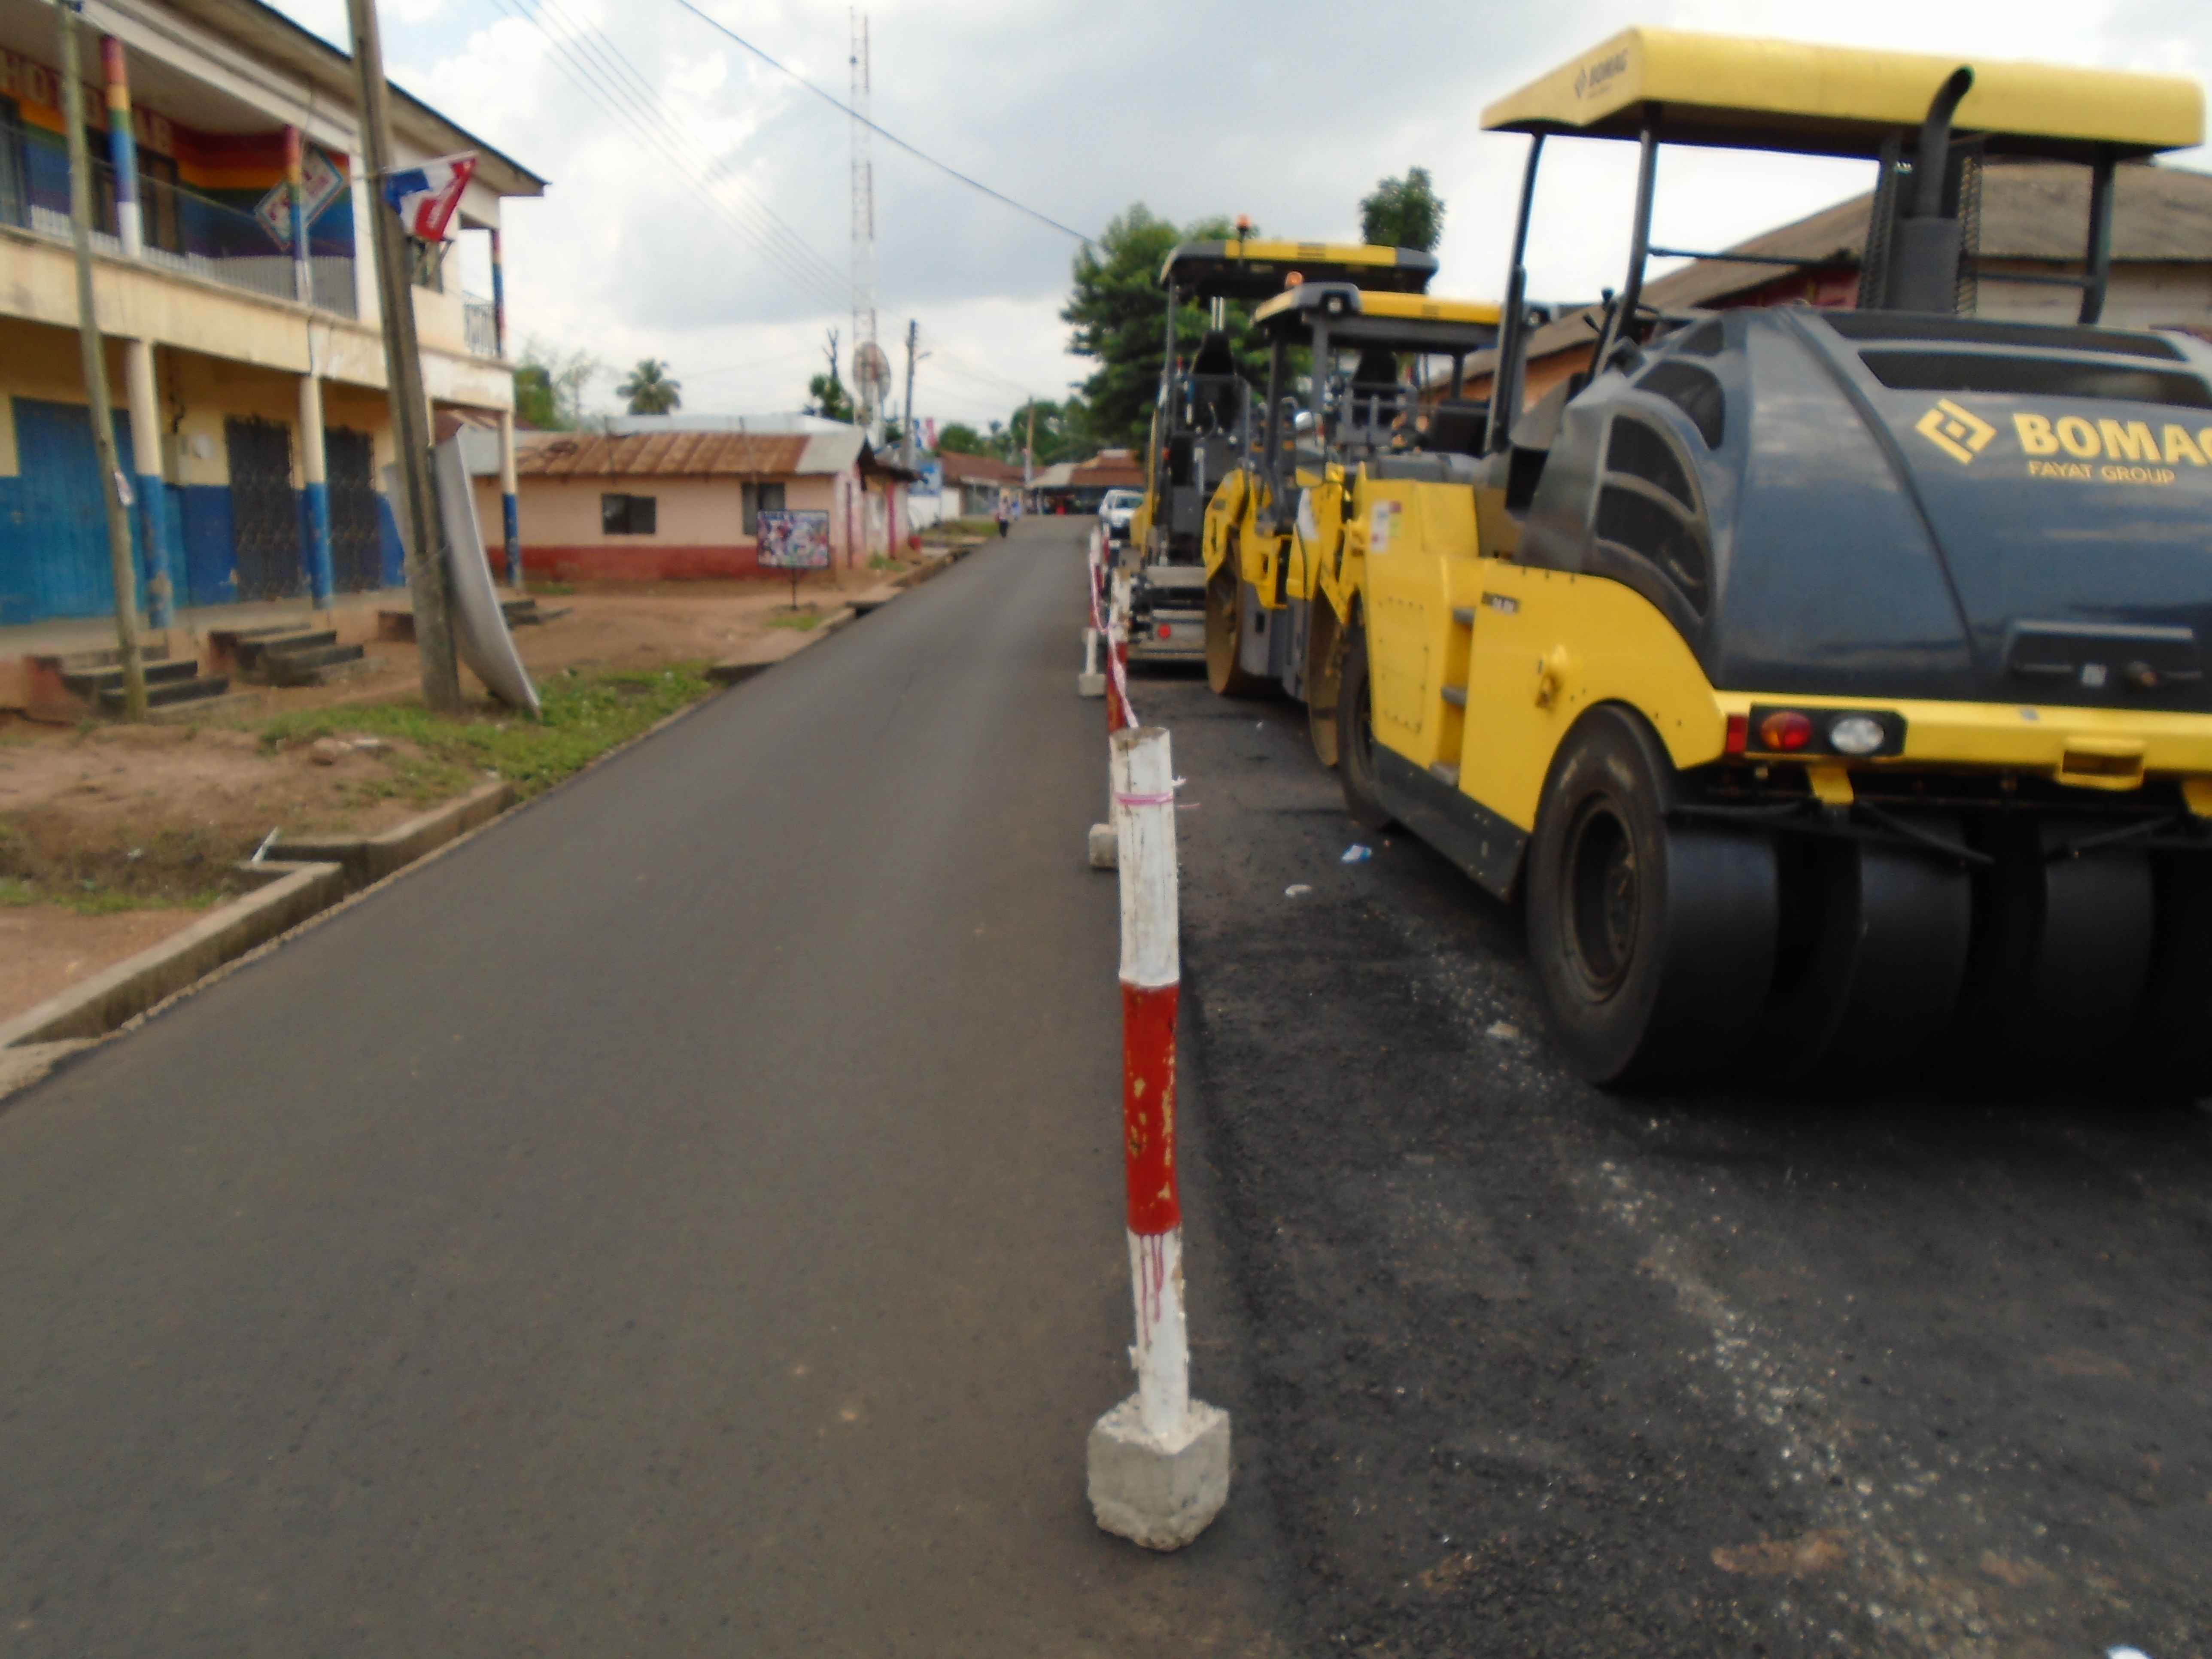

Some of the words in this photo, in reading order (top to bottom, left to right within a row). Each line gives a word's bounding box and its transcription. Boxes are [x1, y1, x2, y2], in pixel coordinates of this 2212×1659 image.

[2012, 413, 2212, 466] BOMA
[2028, 461, 2093, 480] FAYAT
[2101, 465, 2176, 485] GROUP
